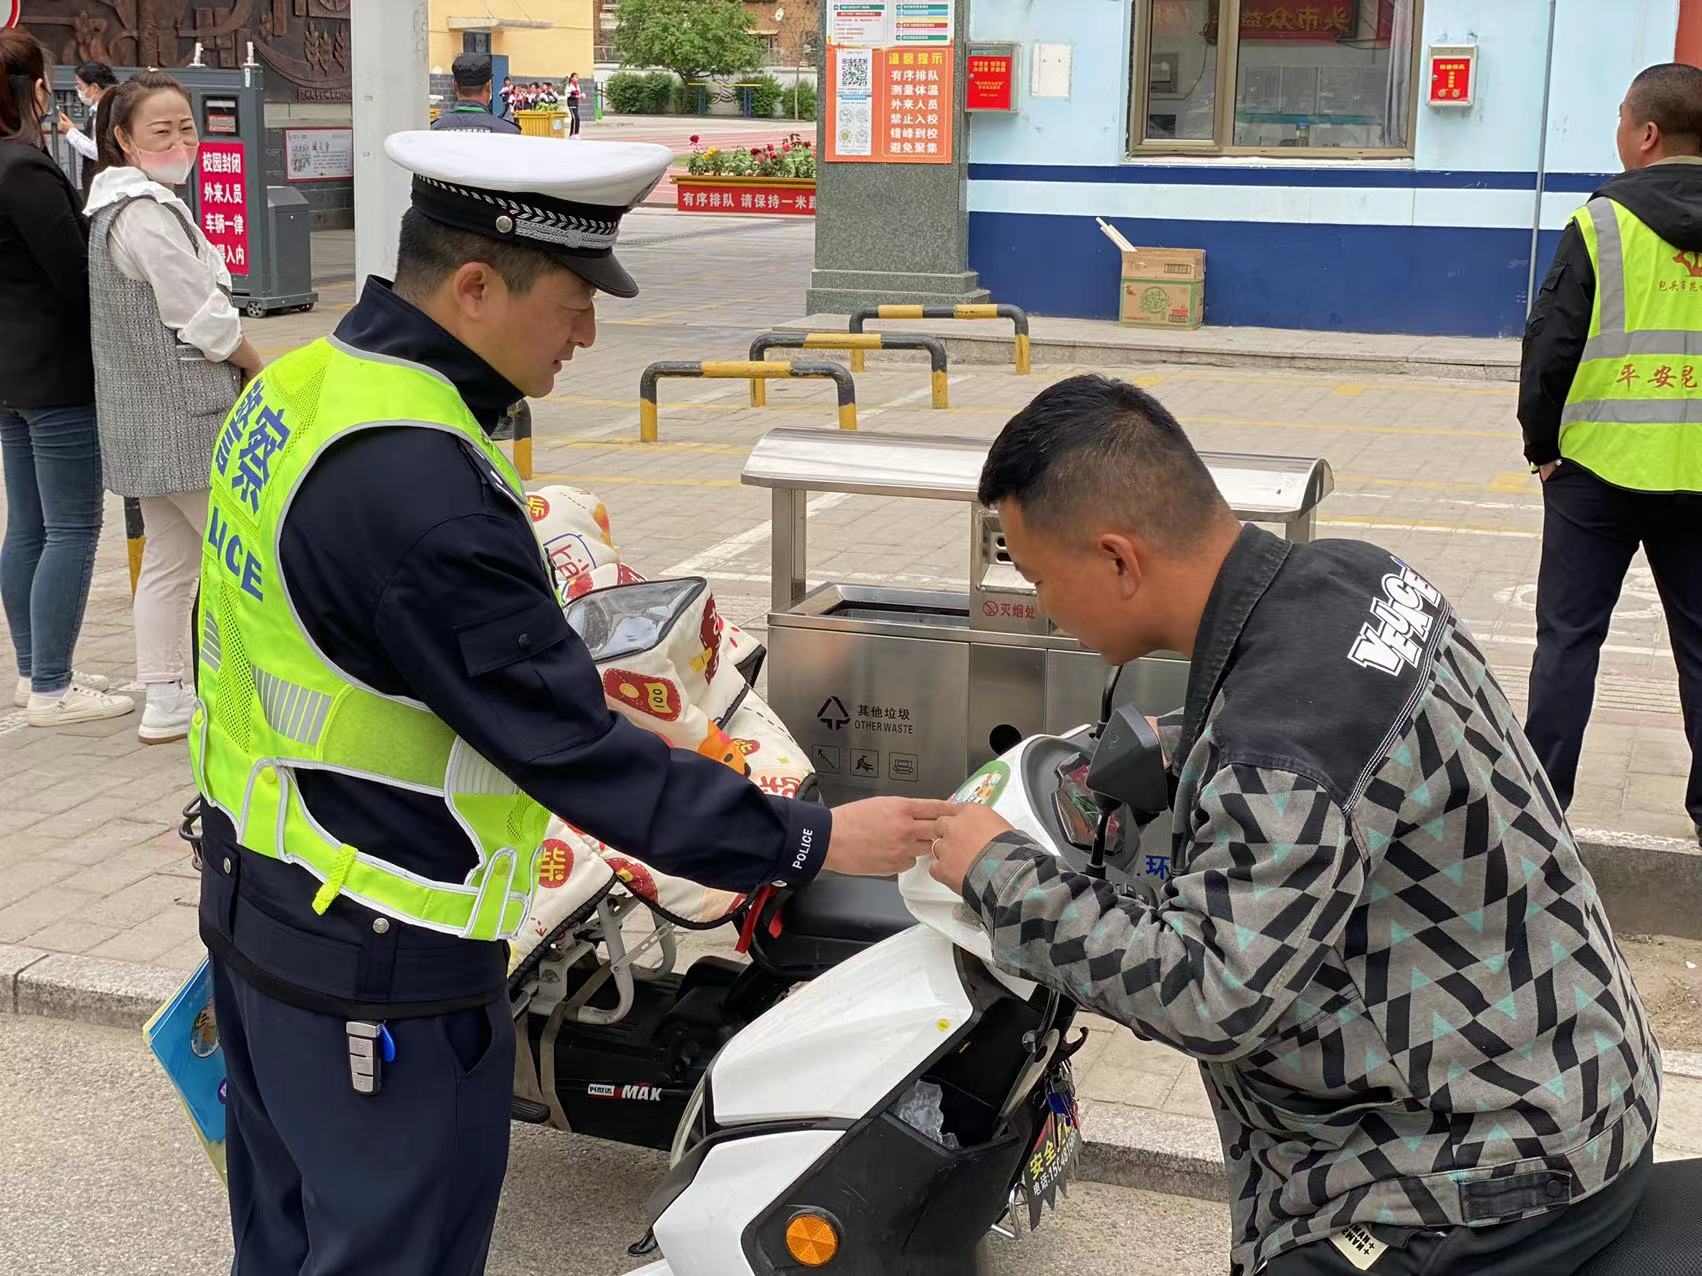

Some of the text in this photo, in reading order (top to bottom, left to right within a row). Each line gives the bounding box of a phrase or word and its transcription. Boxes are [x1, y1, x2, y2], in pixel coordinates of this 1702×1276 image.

[890, 70, 939, 81] 有序排队
[890, 85, 939, 96] 测量体温
[890, 99, 938, 110] 外来人员
[890, 114, 938, 125] 禁止入校
[890, 128, 938, 139] 错峰到校
[889, 142, 938, 154] 避免聚集
[202, 151, 242, 174] 校园封闭
[204, 182, 243, 204] 外来人员
[683, 192, 735, 207] 有序排队
[205, 213, 244, 235] 车辆一律
[213, 243, 245, 266] 得入内
[1000, 603, 1037, 619] 灭烟处
[858, 704, 910, 720] 其他垃圾
[854, 719, 913, 735] OTHER WASTE
[792, 828, 813, 869] POLICE
[1145, 854, 1171, 880] 环
